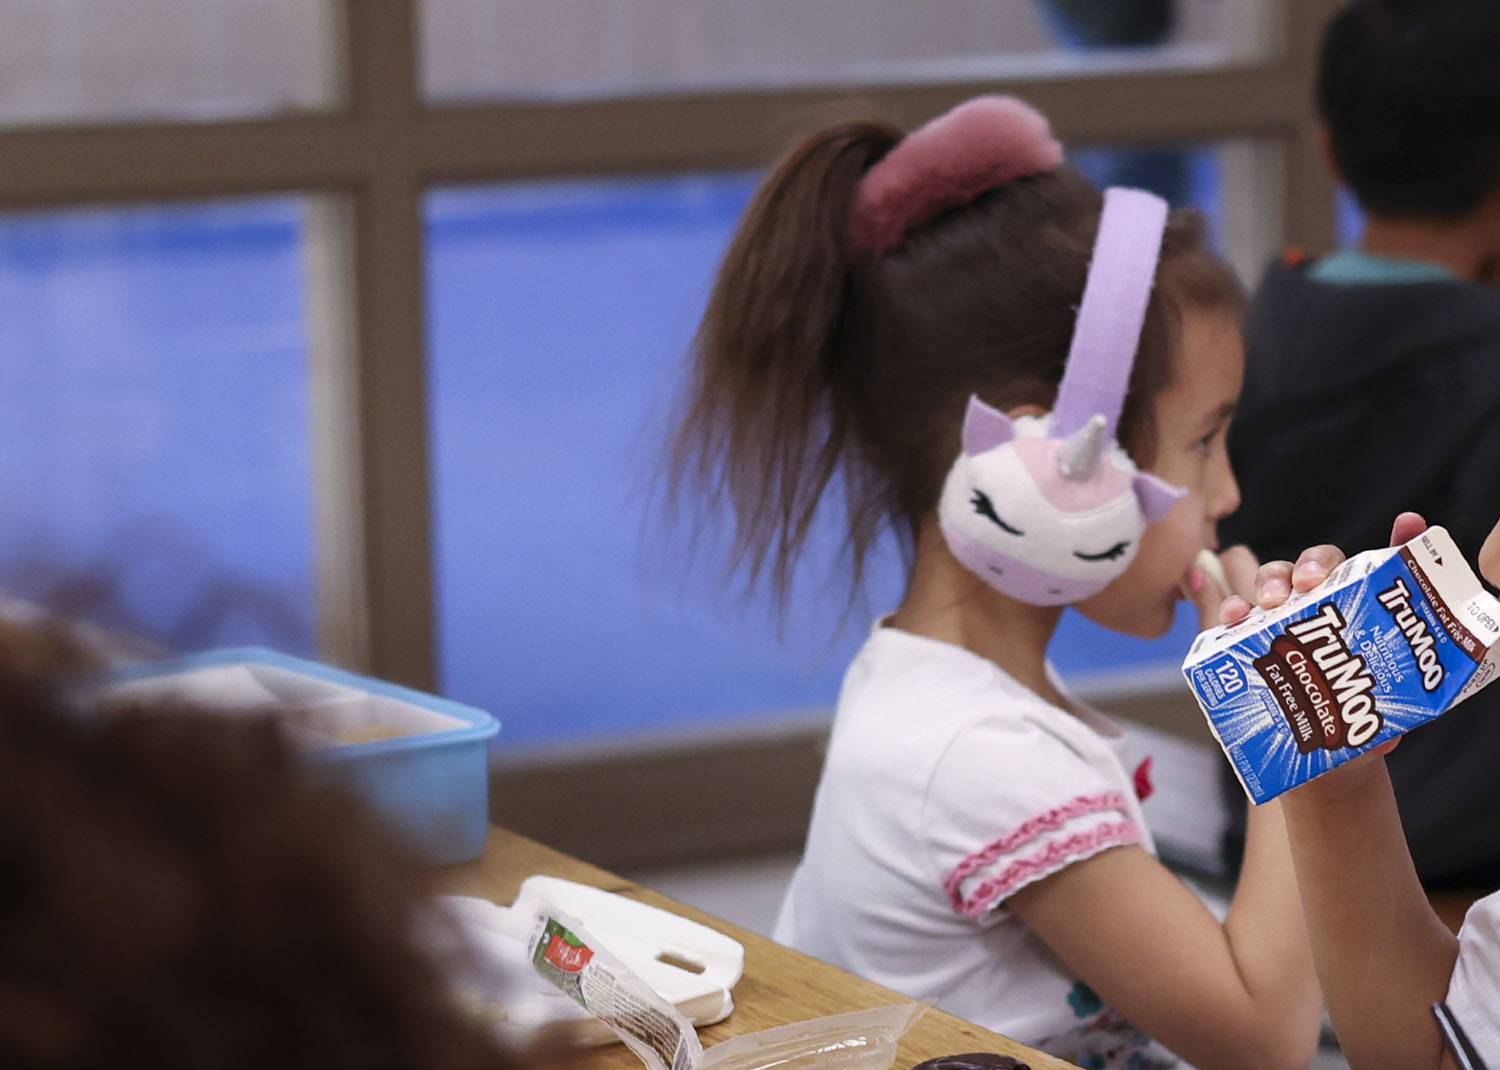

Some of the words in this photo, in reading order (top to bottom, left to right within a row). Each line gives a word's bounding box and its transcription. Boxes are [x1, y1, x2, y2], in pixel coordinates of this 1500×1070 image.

[1407, 559, 1439, 607] Chocolate
[1436, 606, 1450, 625] Fat
[1446, 622, 1464, 642] Free
[1467, 602, 1478, 616] TO
[1478, 612, 1497, 633] OPEN
[1354, 629, 1366, 641] &
[1360, 641, 1393, 694] Delicious
[1369, 625, 1404, 684] Nutritious
[1377, 578, 1444, 691] TruMoo
[1194, 669, 1206, 683] PER
[1204, 668, 1226, 700] CALORIES
[1215, 660, 1244, 694] 120
[1265, 663, 1285, 686] Fat
[1278, 682, 1299, 712] Free
[1293, 710, 1314, 742] Milk
[1285, 650, 1336, 737] Chocolate
[1288, 604, 1380, 747] TruMoo
